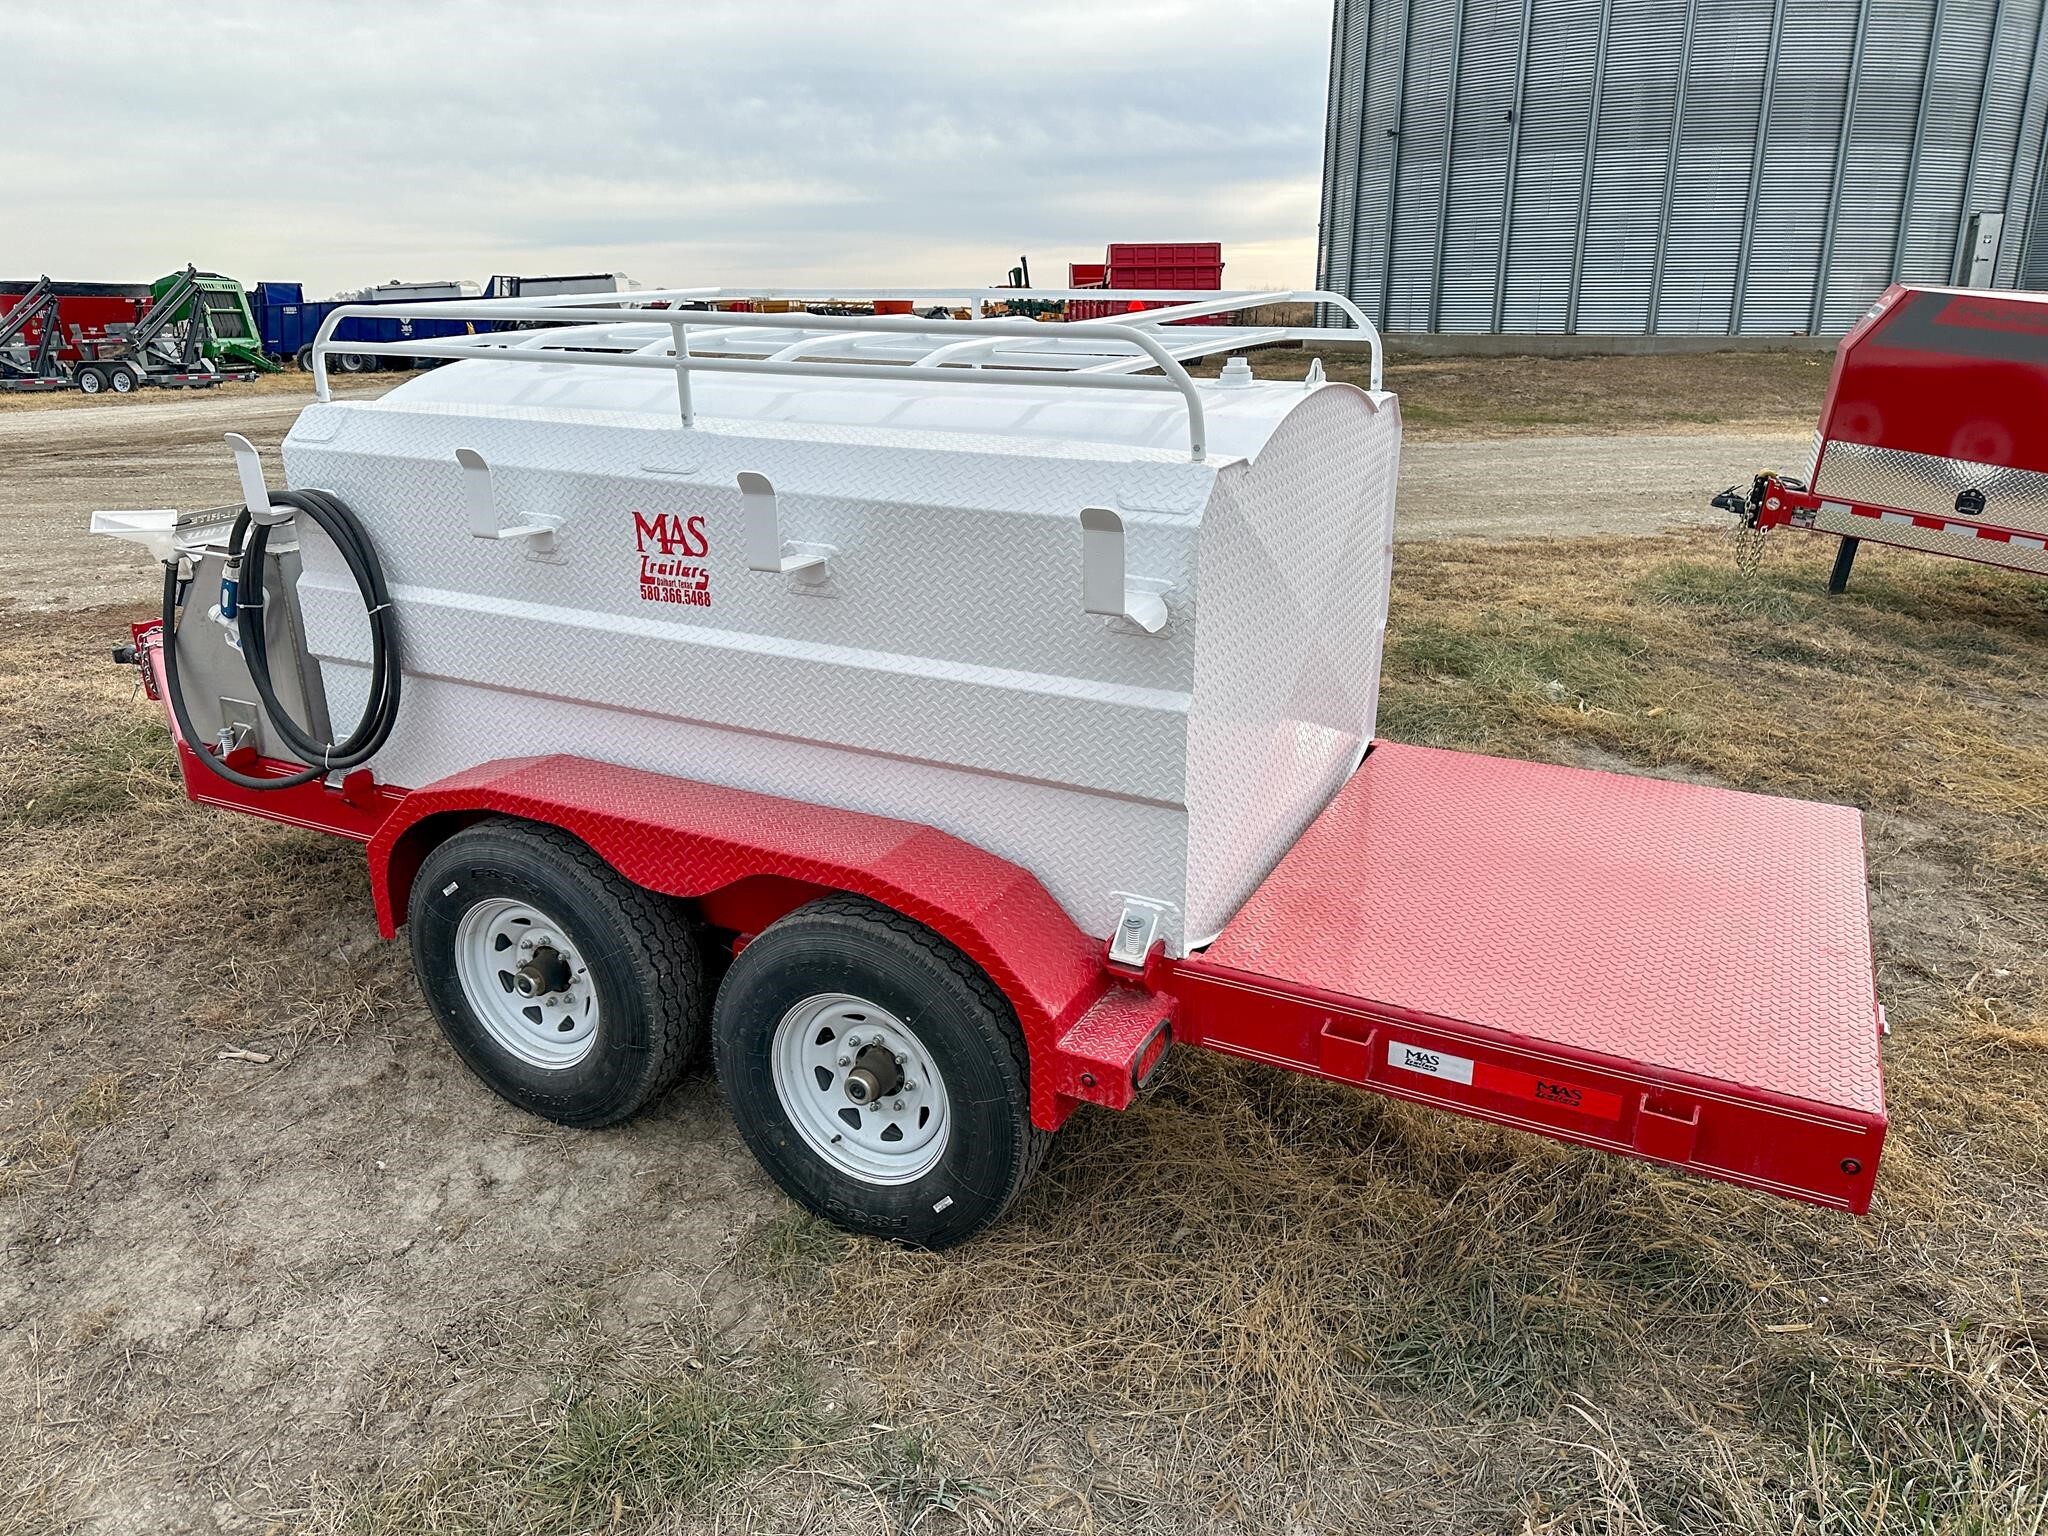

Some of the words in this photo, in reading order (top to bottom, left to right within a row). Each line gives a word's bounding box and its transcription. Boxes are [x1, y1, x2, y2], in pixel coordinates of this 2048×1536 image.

[632, 511, 708, 558] MAS
[640, 555, 709, 590] Trailers
[678, 579, 693, 590] Texas
[640, 585, 711, 607] 580.366.5488
[1405, 1049, 1440, 1066] MAS
[1536, 1080, 1583, 1100] MAS
